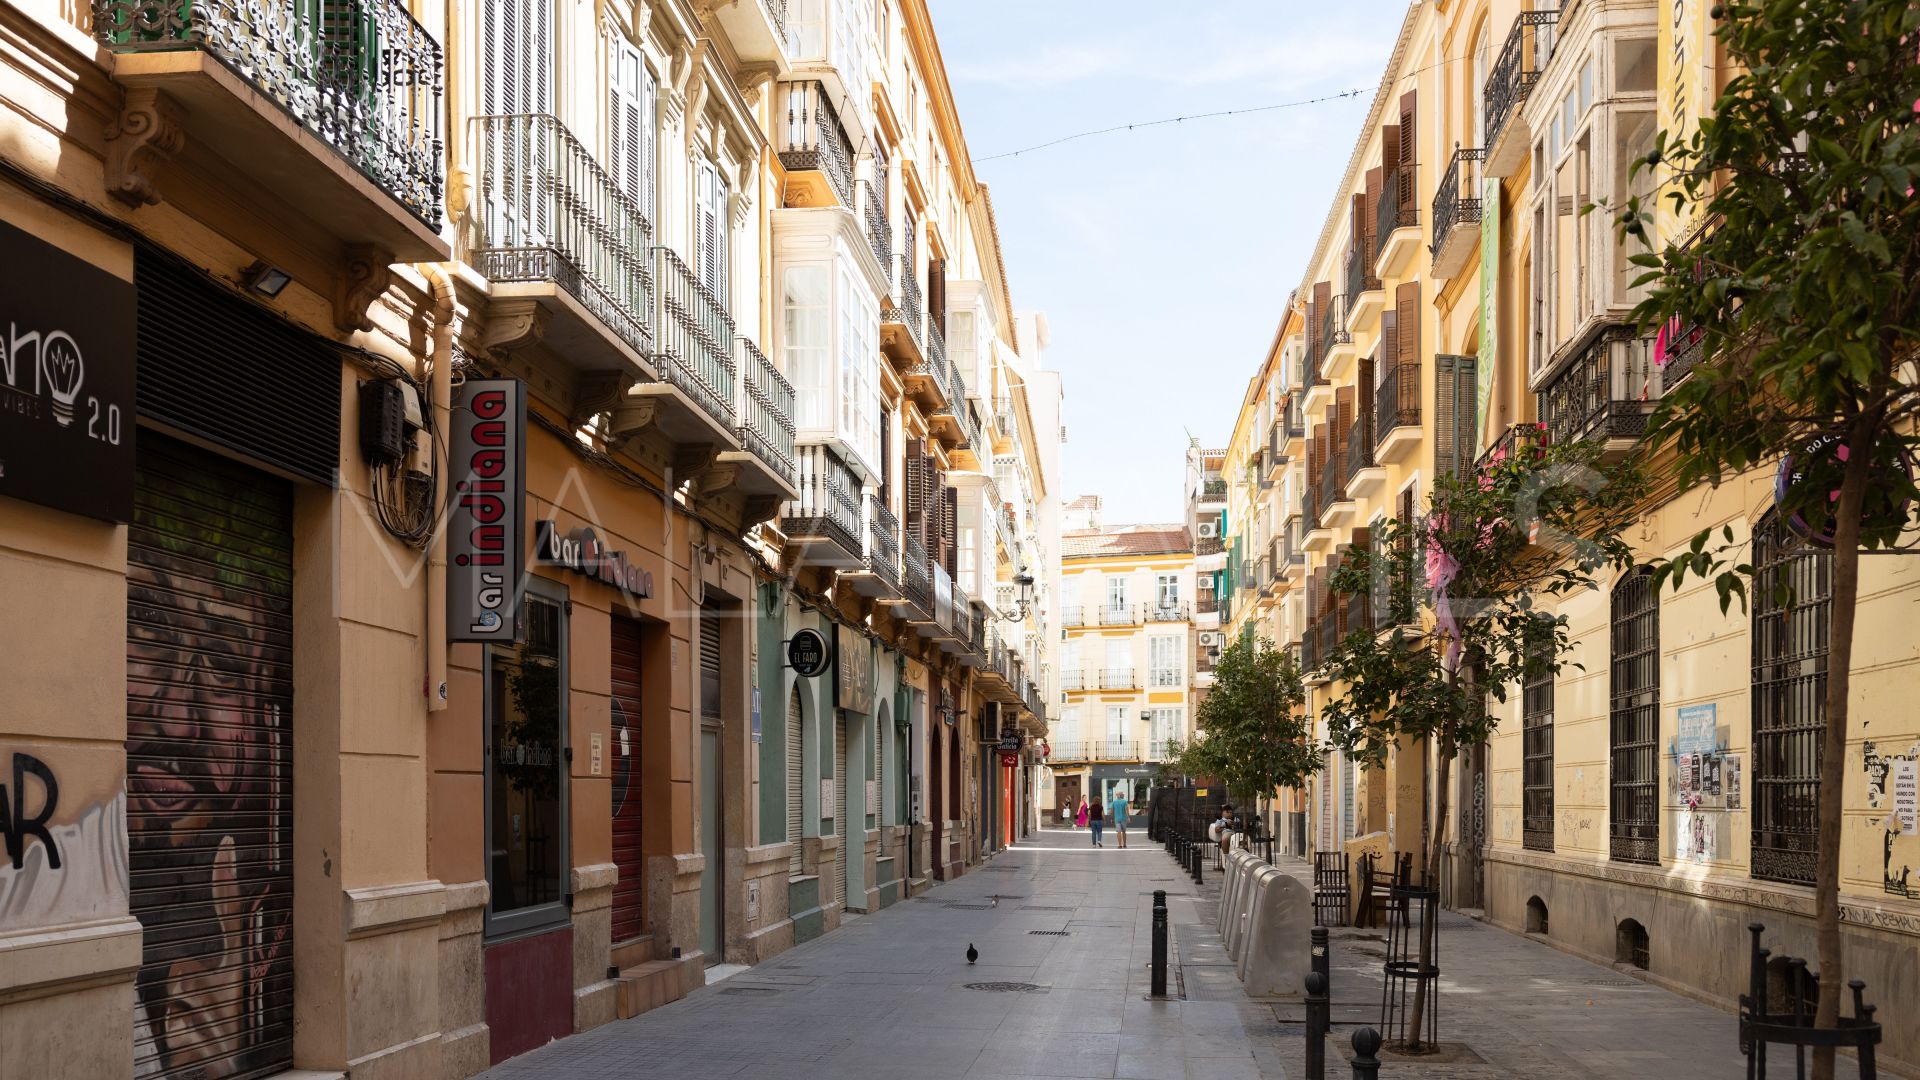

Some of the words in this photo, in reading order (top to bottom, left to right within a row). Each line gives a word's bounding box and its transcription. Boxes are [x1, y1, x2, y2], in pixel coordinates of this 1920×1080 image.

[88, 396, 120, 446] 2.0
[455, 390, 507, 567] indiana
[550, 522, 581, 568] bar
[598, 541, 655, 600] indiana
[470, 573, 504, 633] bar
[794, 652, 801, 663] EL
[802, 652, 818, 663] FARO
